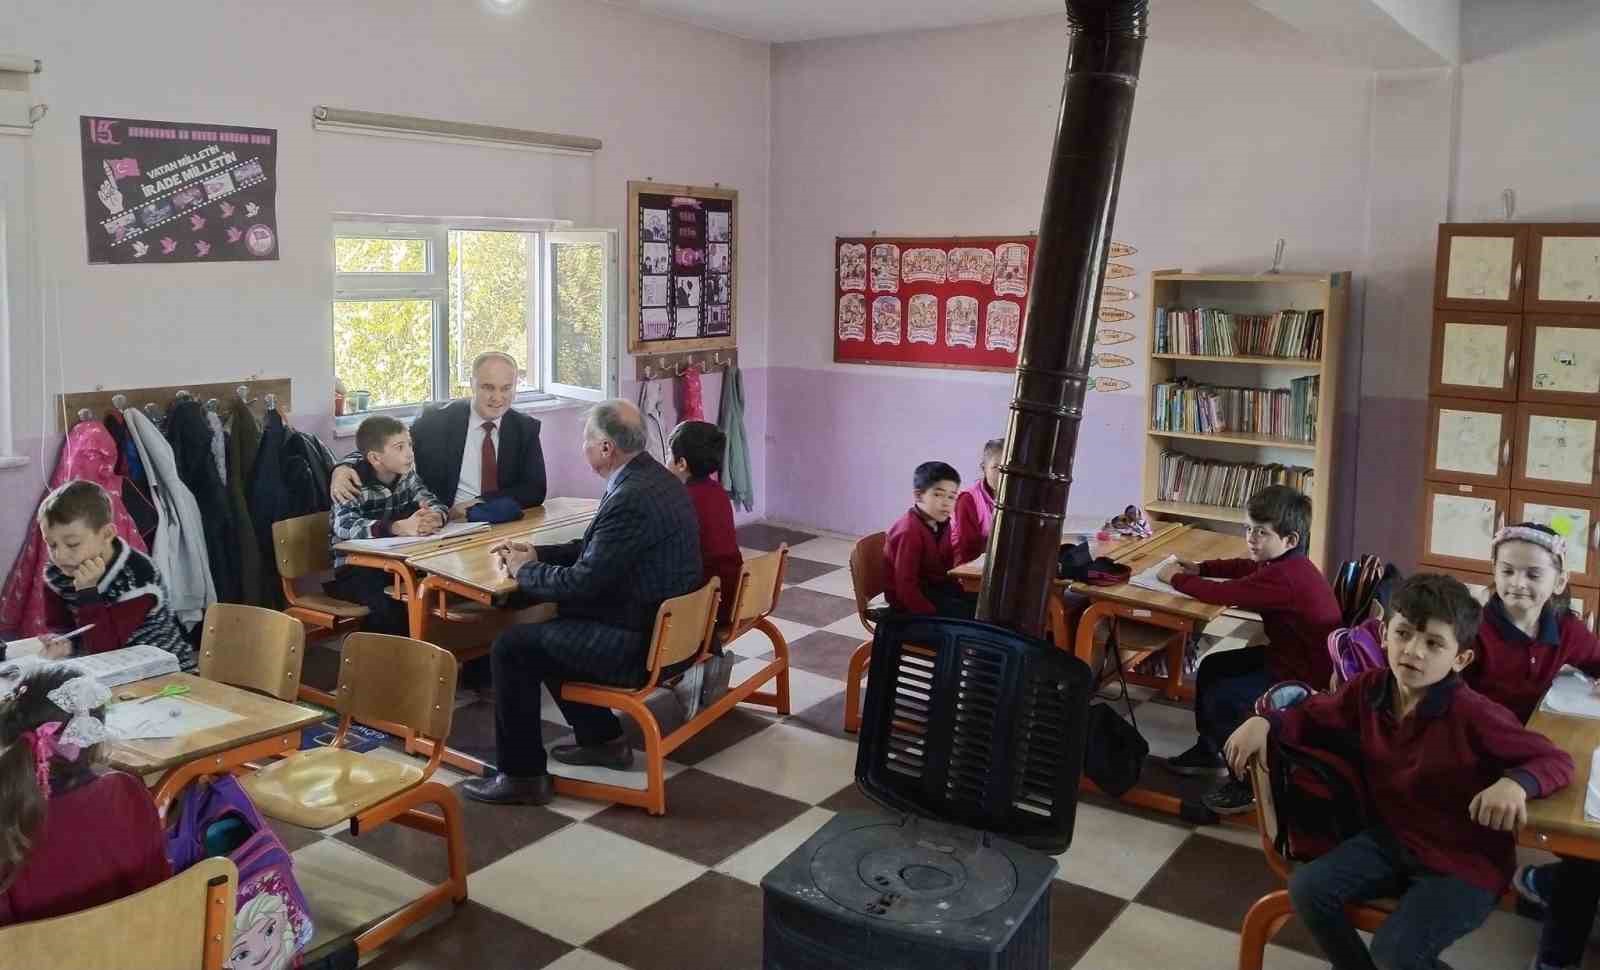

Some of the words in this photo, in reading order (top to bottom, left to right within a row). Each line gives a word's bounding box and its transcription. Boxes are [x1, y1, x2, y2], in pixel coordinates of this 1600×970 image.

[140, 173, 180, 198] İRADE
[181, 151, 237, 181] MİLLETİN
[146, 160, 178, 179] VATAN
[178, 144, 220, 168] MİLLETİN
